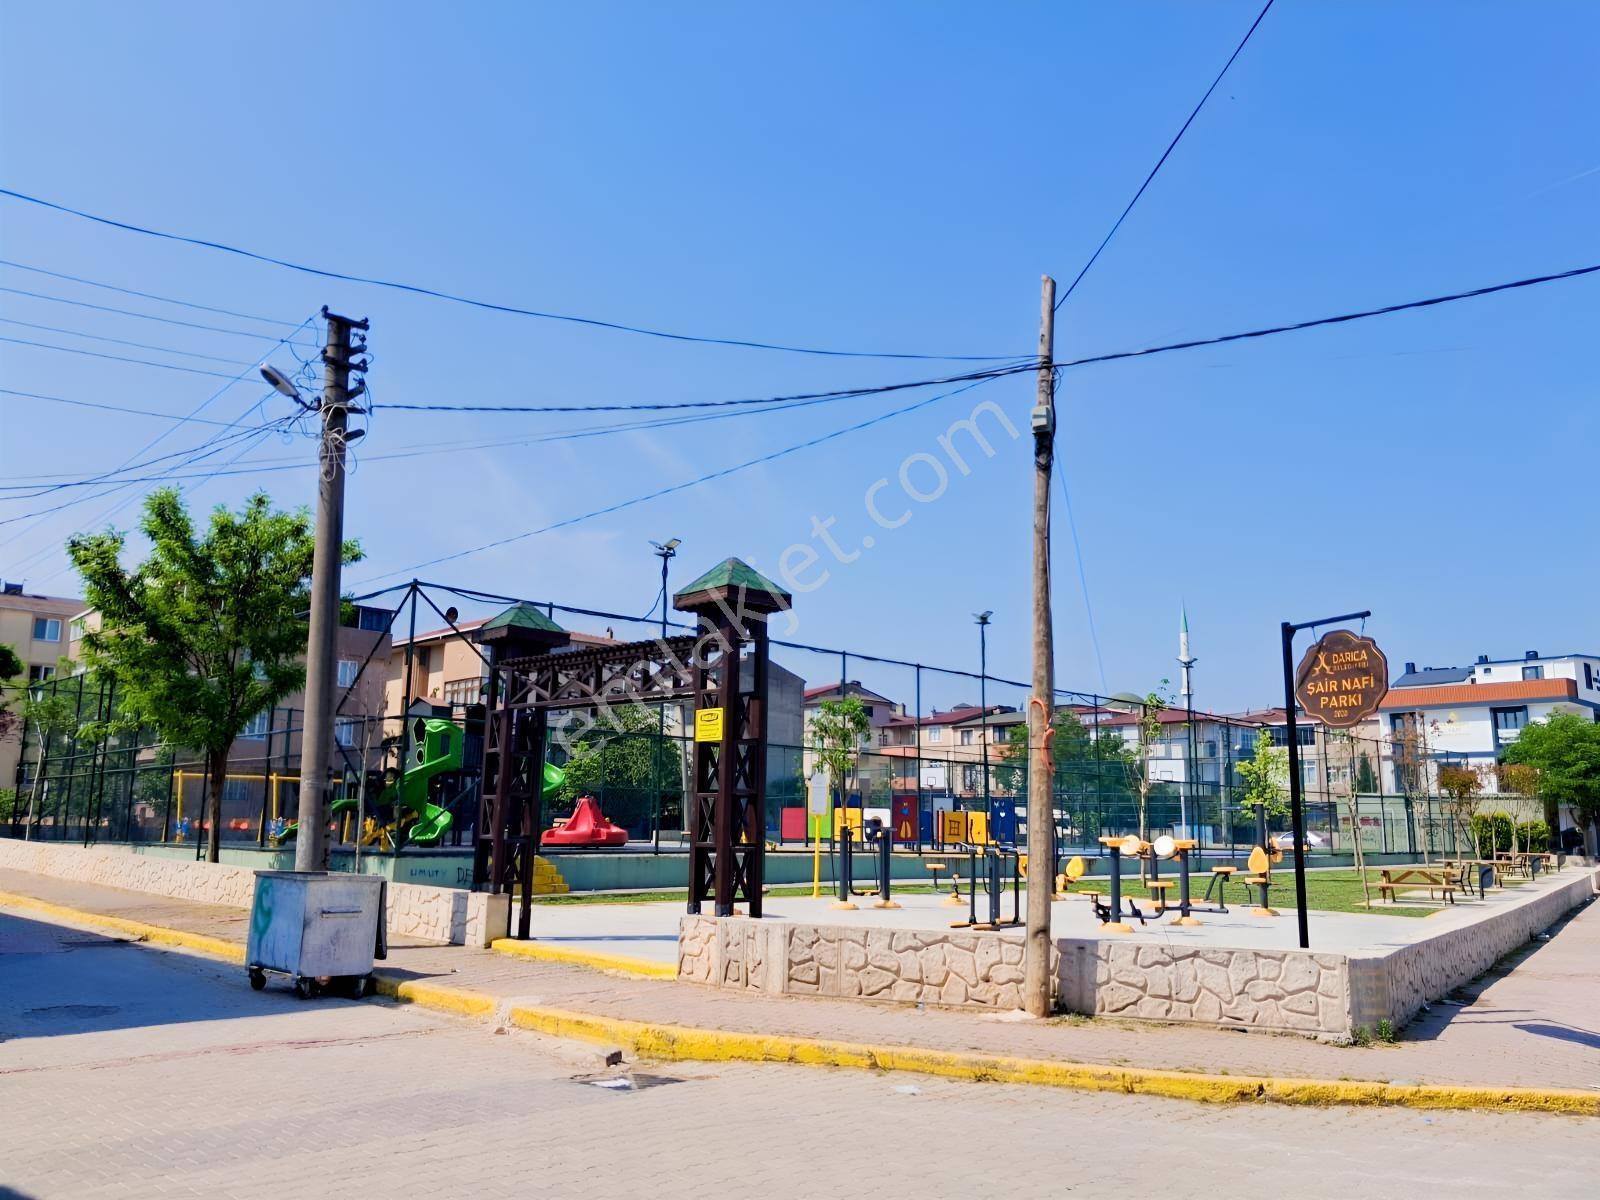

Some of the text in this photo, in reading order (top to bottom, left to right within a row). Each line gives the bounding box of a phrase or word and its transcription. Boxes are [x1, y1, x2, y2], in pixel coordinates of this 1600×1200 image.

[1332, 650, 1367, 664] DARICA
[1307, 673, 1374, 696] ŞAİR NAFİ
[1320, 694, 1362, 709] PARKI
